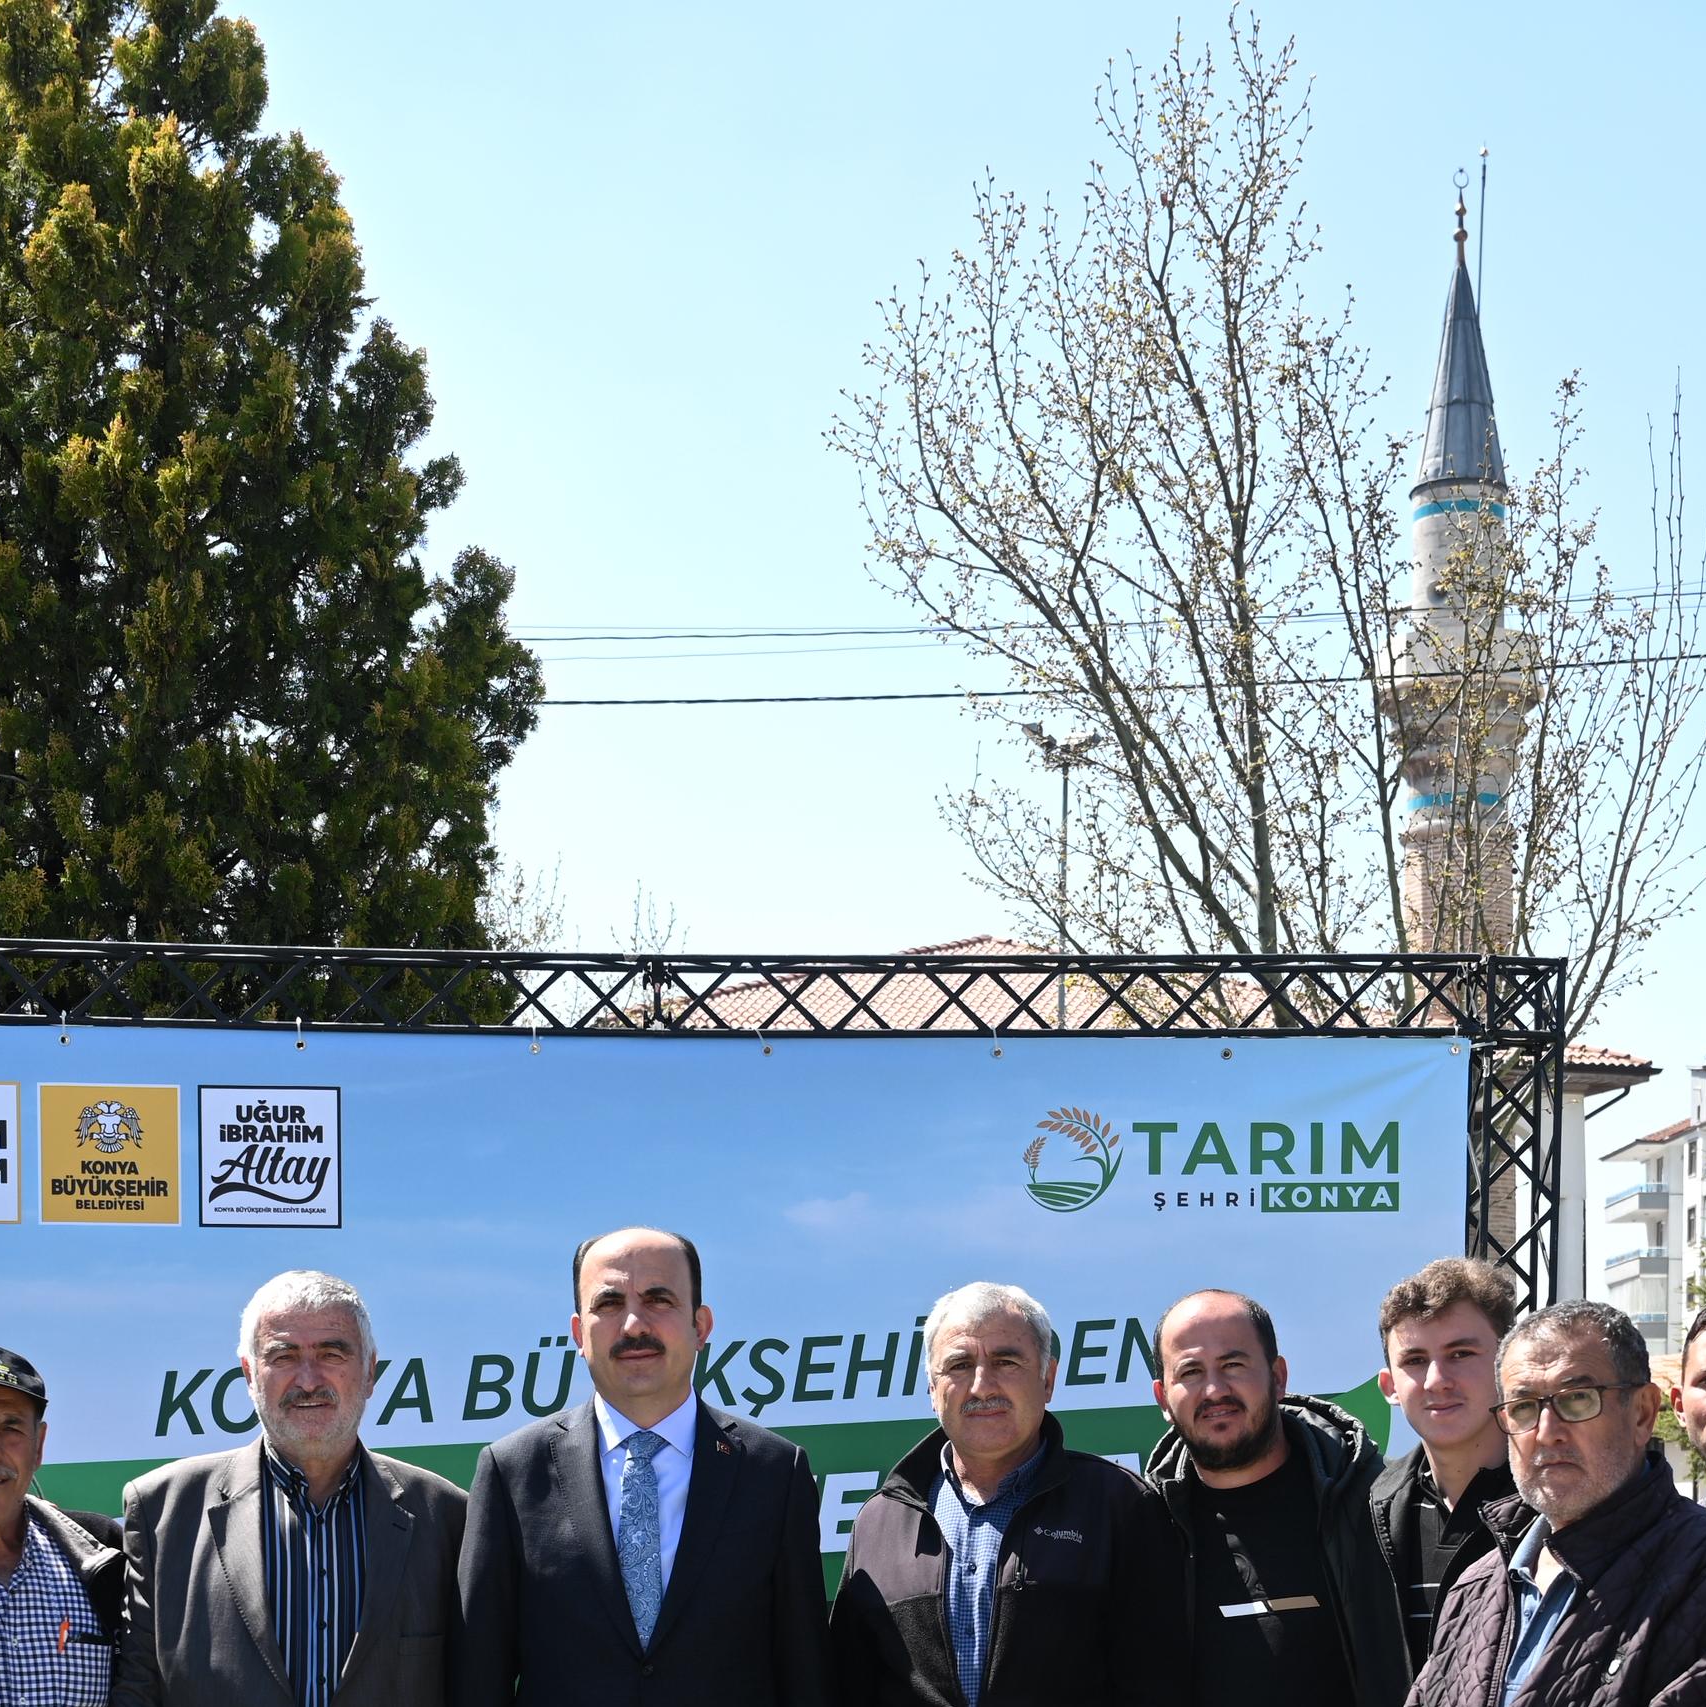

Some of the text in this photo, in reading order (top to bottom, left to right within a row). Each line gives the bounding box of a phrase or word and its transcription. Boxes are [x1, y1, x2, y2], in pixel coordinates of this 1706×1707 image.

[236, 1099, 306, 1124] UĞUR
[1132, 1121, 1399, 1176] TARIM
[80, 1160, 139, 1175] KONYA
[209, 1143, 332, 1204] Altay
[51, 1175, 169, 1199] BÜYÜKŞEHİR
[1153, 1186, 1394, 1211] ŞEHRİ KONYA
[75, 1197, 145, 1211] BELEDİYESİ
